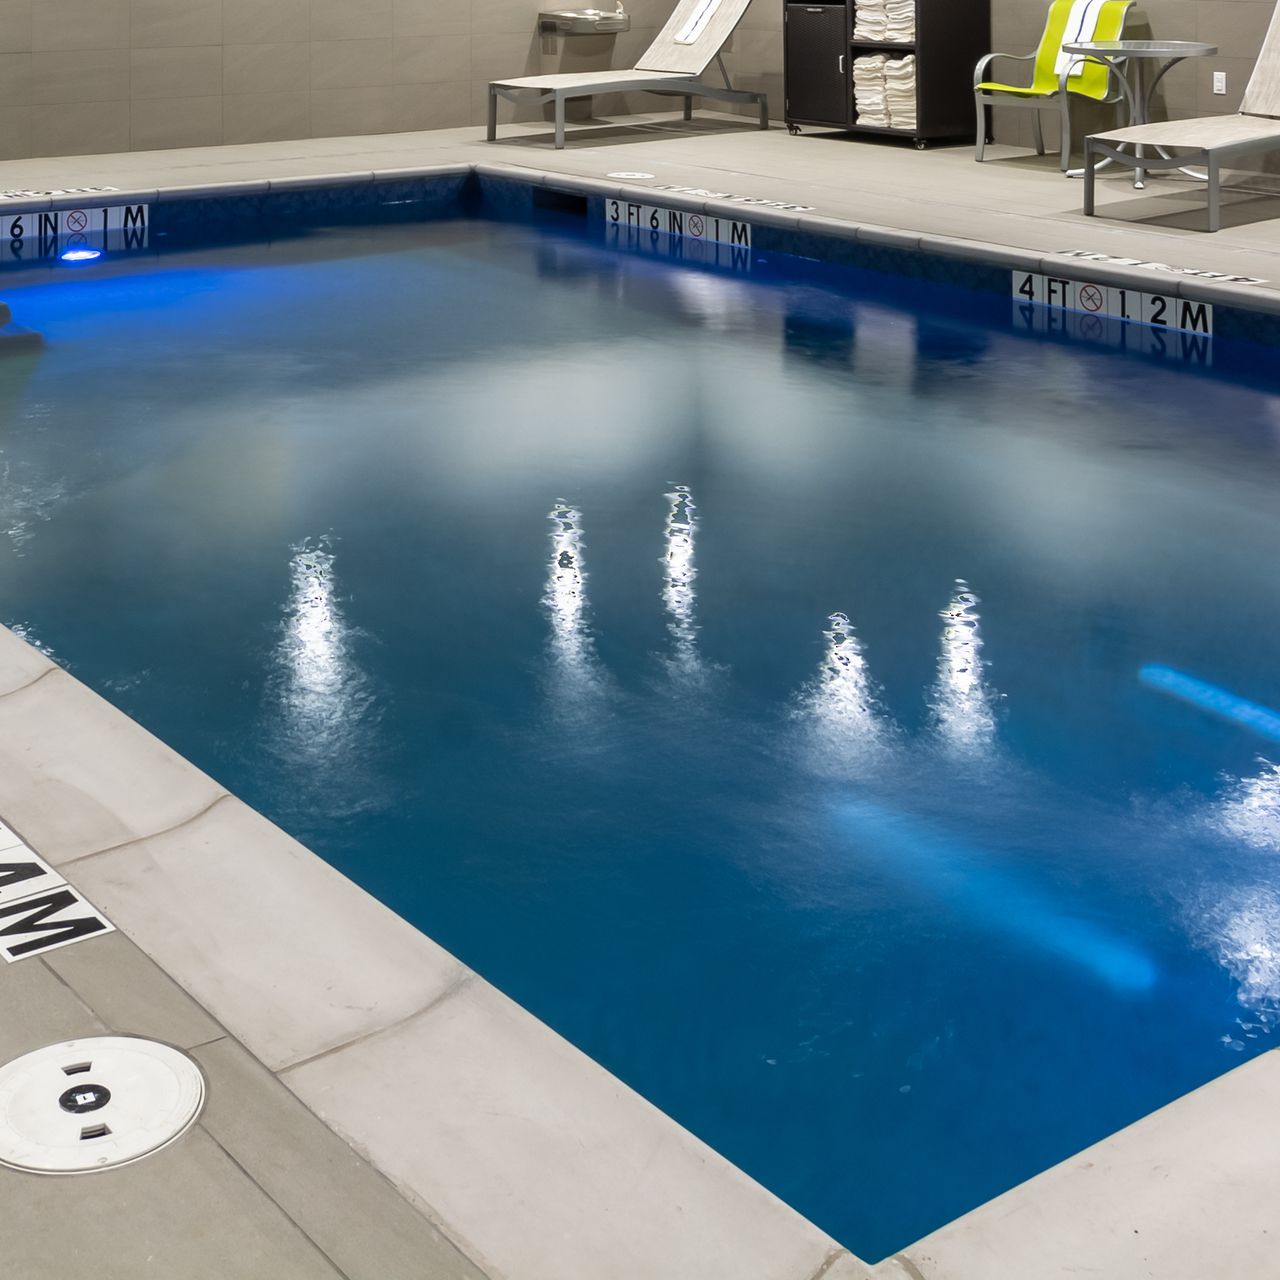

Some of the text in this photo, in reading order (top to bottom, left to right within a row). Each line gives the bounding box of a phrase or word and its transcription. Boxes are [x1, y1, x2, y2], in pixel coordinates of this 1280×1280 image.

[10, 215, 24, 239] 6
[38, 213, 58, 236] IN
[123, 205, 146, 228] M
[611, 201, 620, 221] 3
[627, 204, 642, 226] FT
[649, 209, 659, 230] 6
[669, 211, 683, 234] IN
[731, 222, 748, 246] M
[1019, 274, 1034, 301] 4
[1047, 279, 1070, 307] FT
